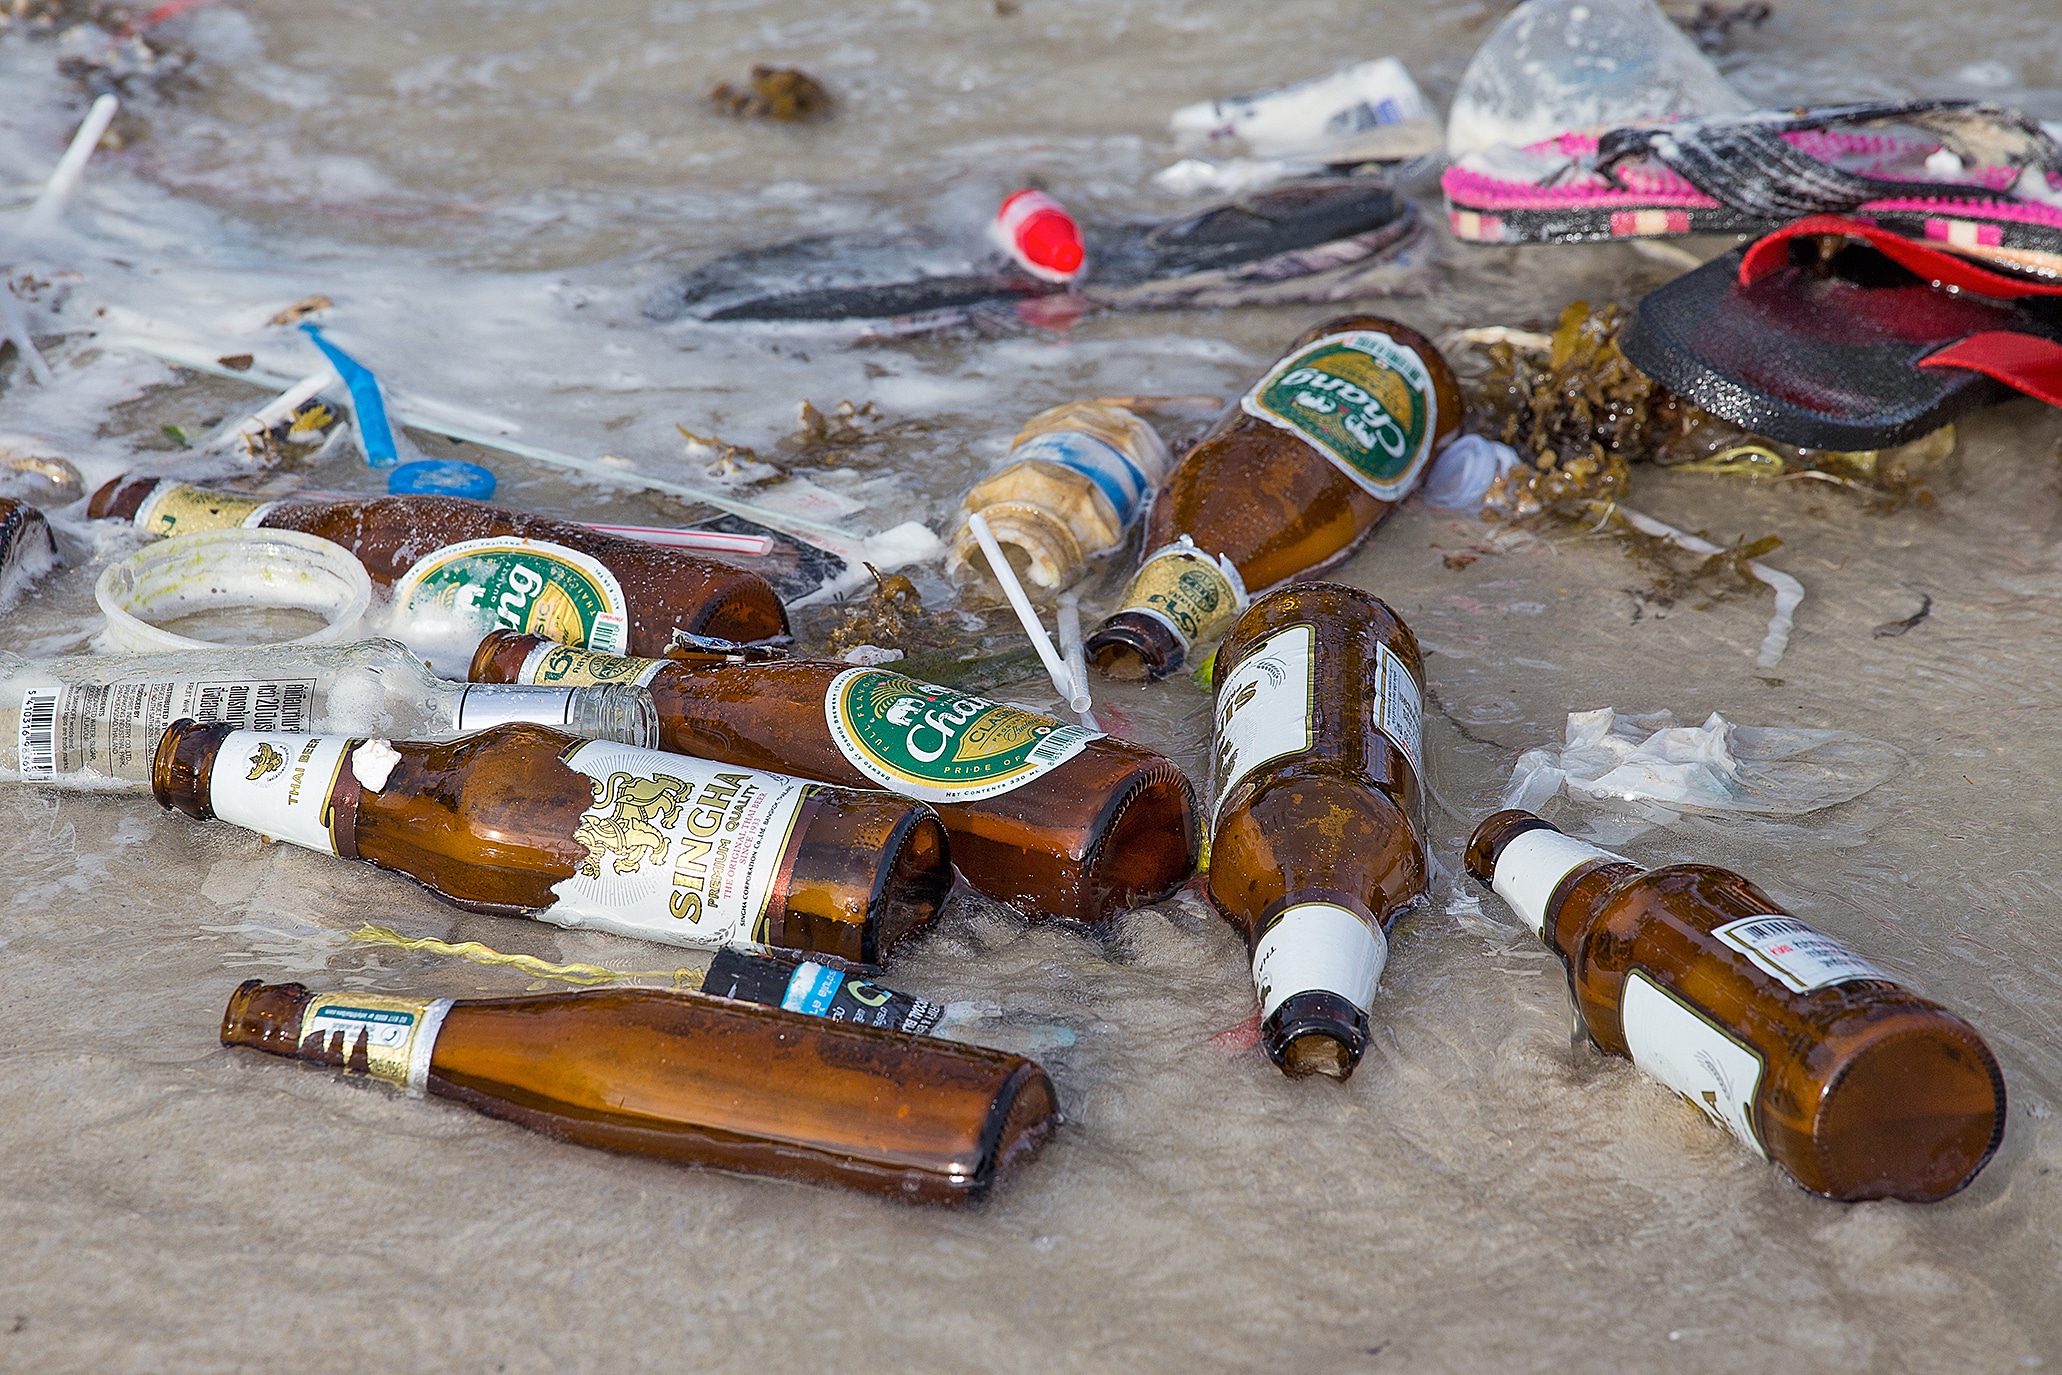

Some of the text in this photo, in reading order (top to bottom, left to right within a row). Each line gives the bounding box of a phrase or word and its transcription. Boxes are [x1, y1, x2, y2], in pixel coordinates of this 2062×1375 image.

[1280, 368, 1406, 457] Chang
[490, 561, 511, 602] QUALITY
[134, 683, 145, 719] PRODUCED BY
[162, 682, 175, 719] DISTRIBUTED
[182, 682, 194, 715] FRUIT WINE
[22, 700, 35, 736] 410316
[62, 712, 70, 726] logos
[125, 712, 133, 737] INDUSTRY
[865, 724, 890, 752] FULL
[62, 752, 70, 771] marks.
[288, 738, 323, 805] THAI BEER
[854, 753, 863, 761] AT
[863, 761, 890, 781] BREWED
[943, 756, 1021, 775] PRIDE OF
[963, 783, 1007, 796] CONTENTS
[1010, 775, 1026, 785] 330
[670, 773, 754, 924] SINGHA
[707, 784, 760, 908] PREMIUM QUALITY
[723, 791, 769, 900] THE ORIGINAL THAI BEER
[739, 817, 761, 865] SINCE 1933
[742, 849, 761, 901] CORPORATION
[740, 901, 748, 927] SINGHA
